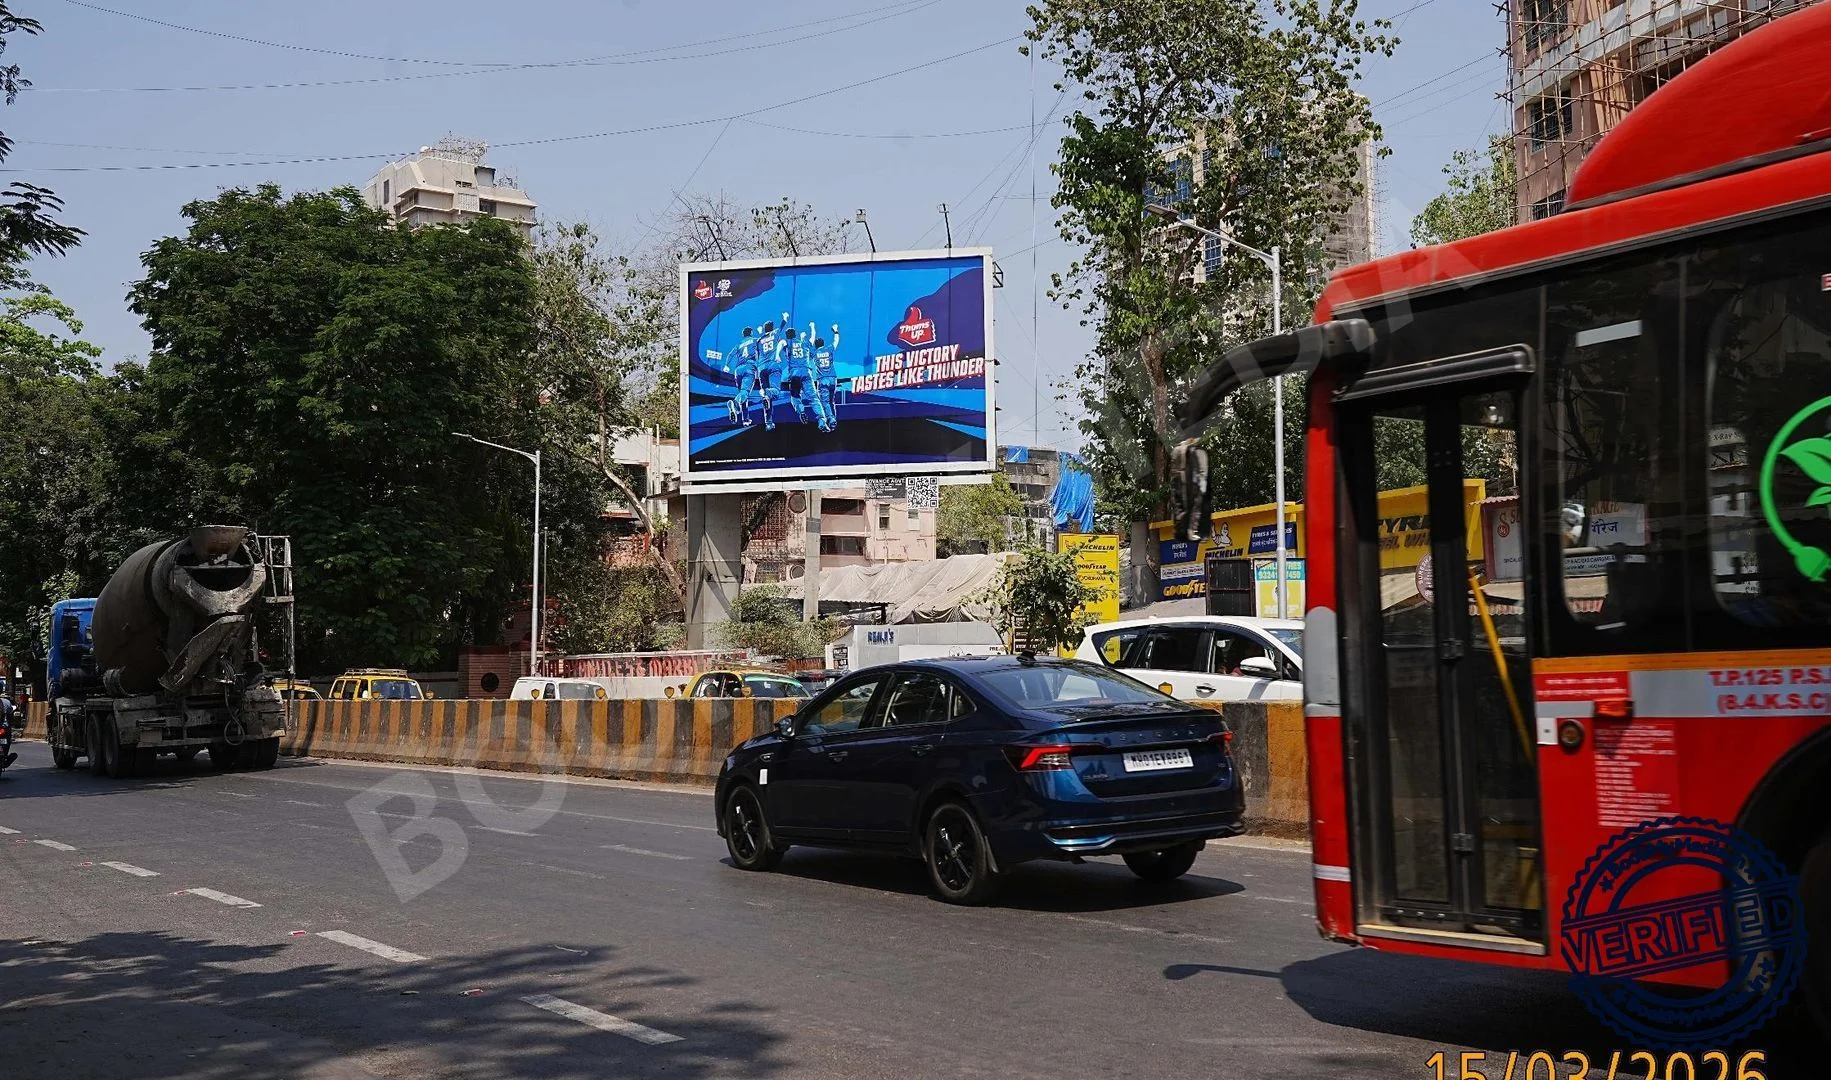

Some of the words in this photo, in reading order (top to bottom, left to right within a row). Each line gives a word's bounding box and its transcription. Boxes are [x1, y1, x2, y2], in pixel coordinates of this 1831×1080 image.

[875, 353, 904, 373] THIS
[906, 344, 960, 367] VICTORY
[851, 372, 895, 394] TASTES
[894, 367, 925, 387] LIKE
[927, 357, 985, 381] THUNDER
[1377, 514, 1431, 534] TYR
[1163, 579, 1206, 598] GOODYE
[1790, 668, 1831, 685] P.S.
